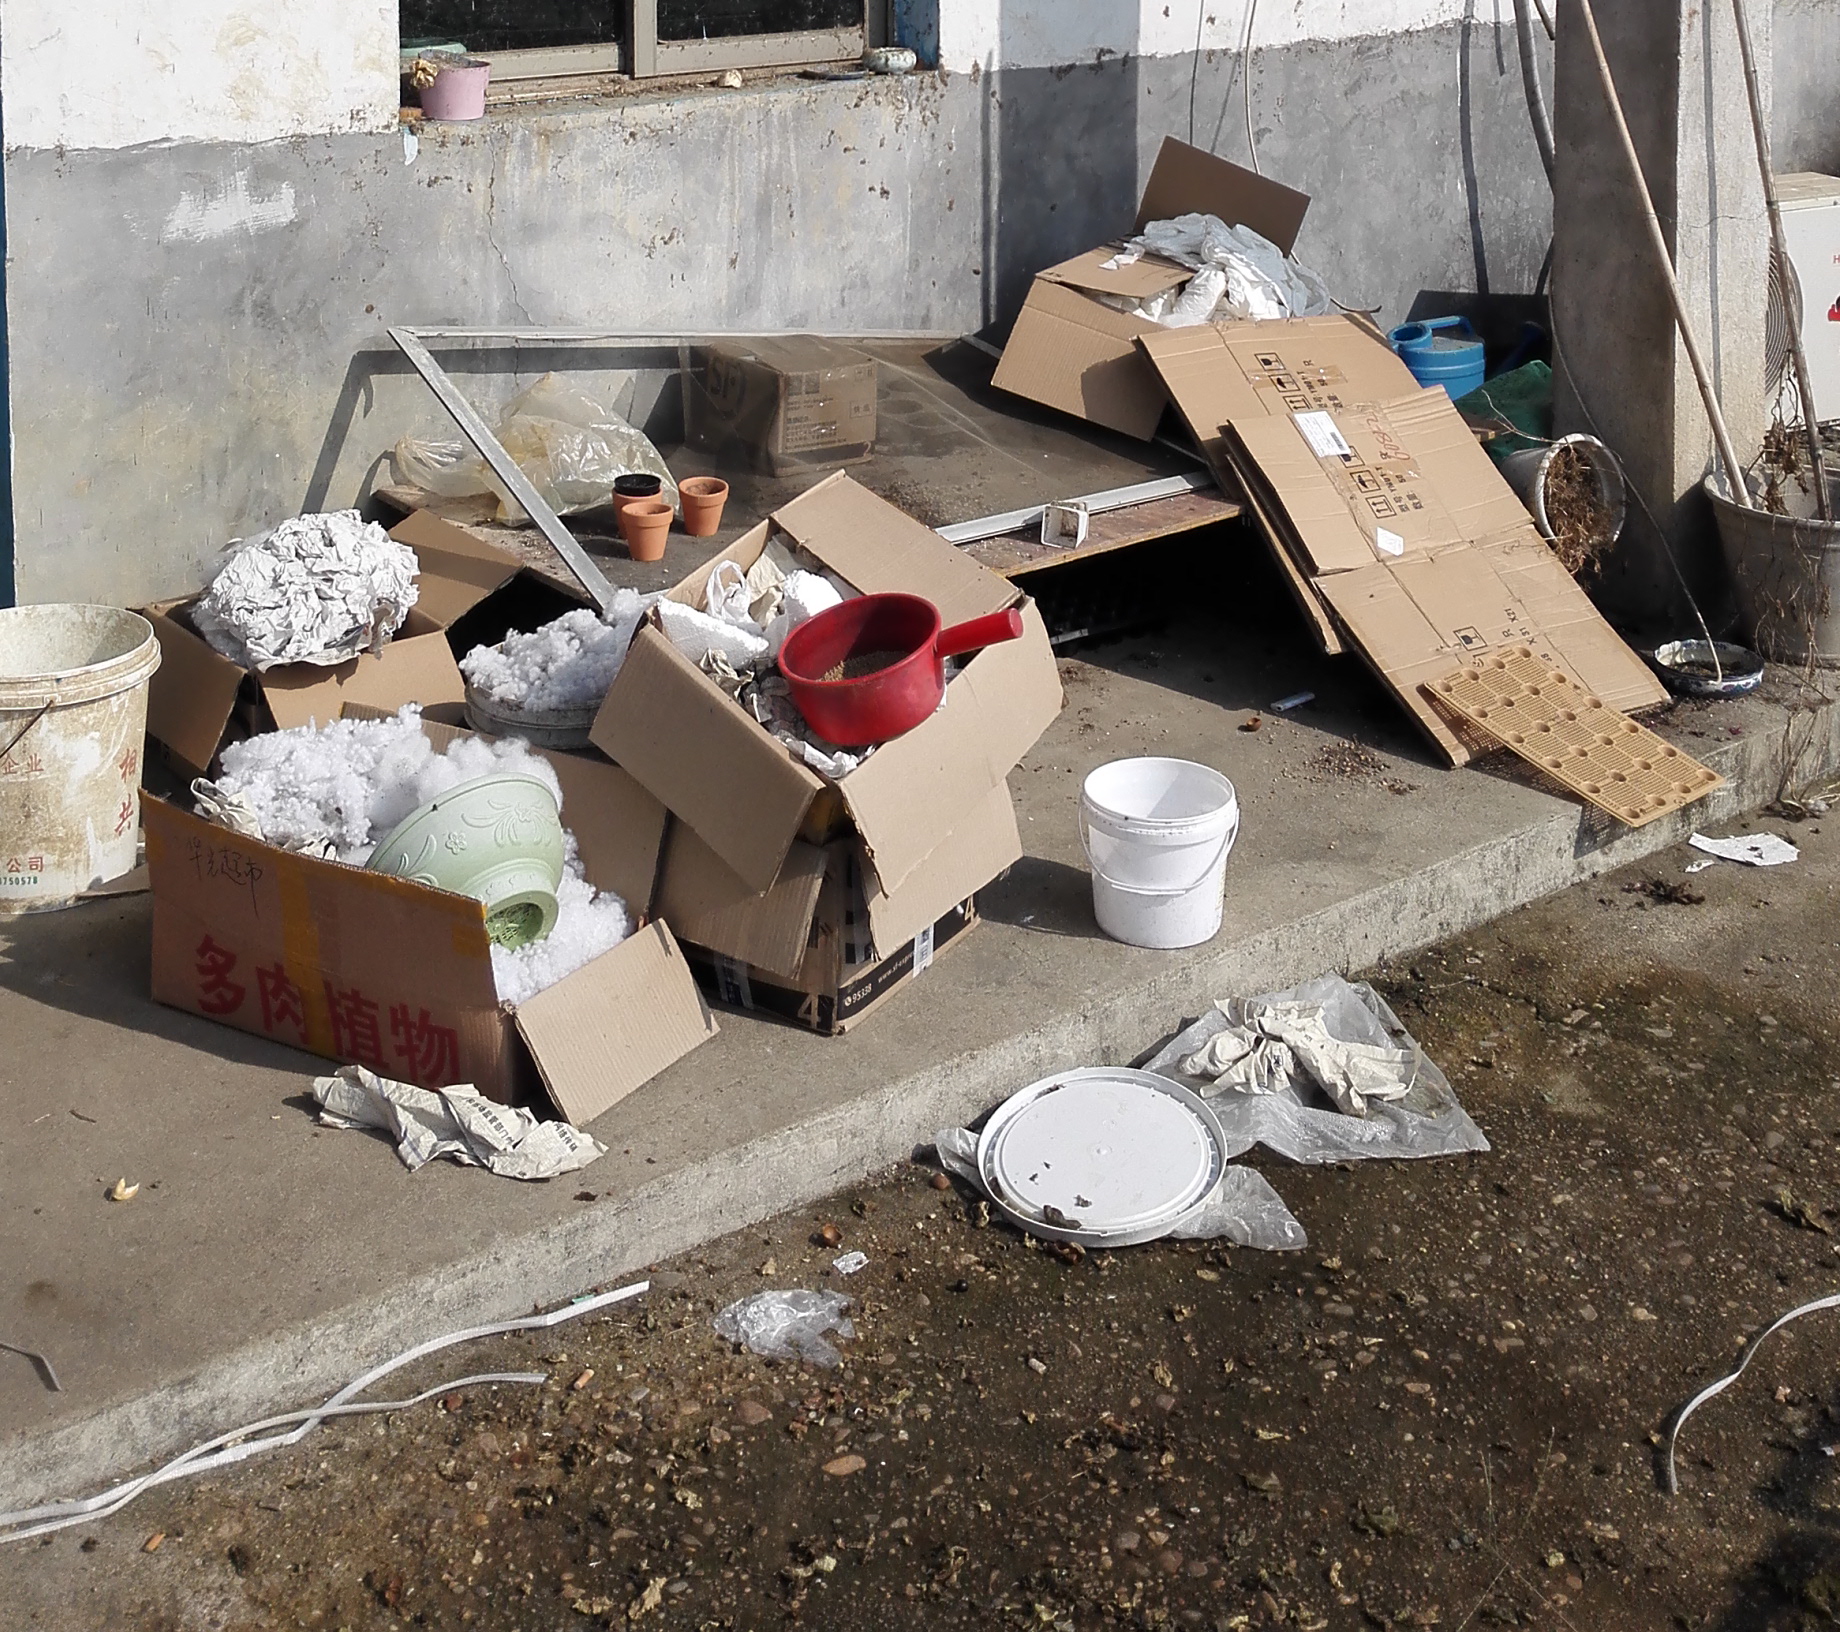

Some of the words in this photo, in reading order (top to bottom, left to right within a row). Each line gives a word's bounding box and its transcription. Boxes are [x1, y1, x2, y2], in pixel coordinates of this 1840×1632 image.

[6, 856, 44, 873] 公司
[851, 982, 873, 1004] 95338
[196, 934, 461, 1091] 多肉植物
